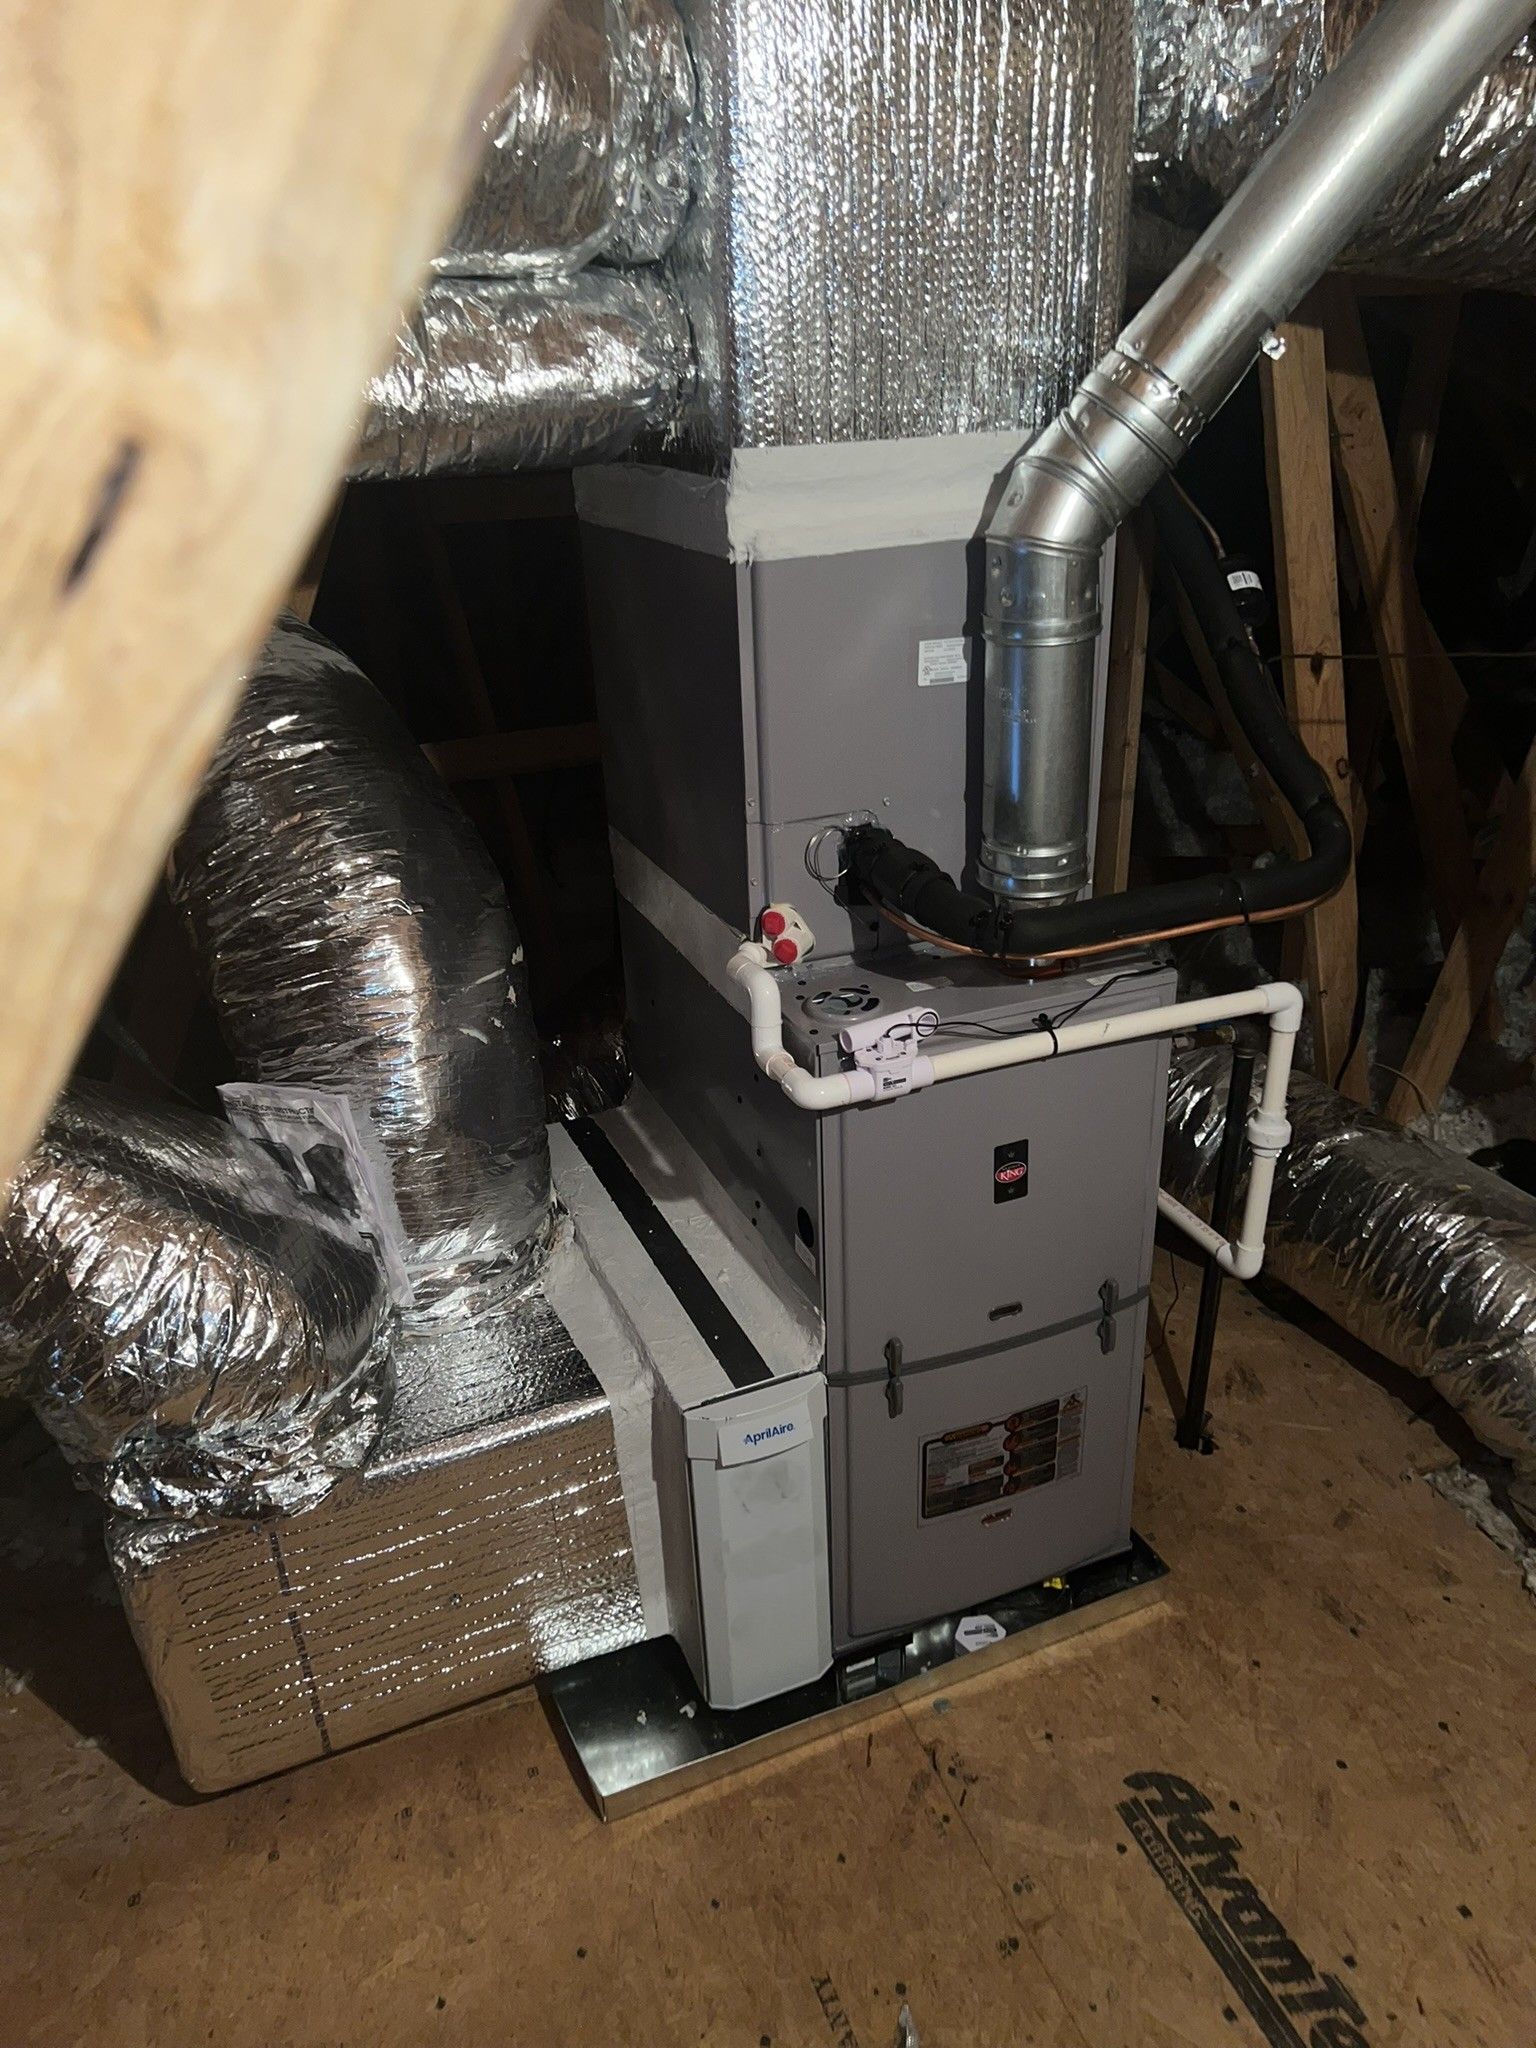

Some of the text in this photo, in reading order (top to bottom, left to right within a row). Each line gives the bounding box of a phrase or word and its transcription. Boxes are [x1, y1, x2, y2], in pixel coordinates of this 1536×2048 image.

[1000, 1167, 1025, 1180] KING
[744, 1423, 794, 1446] AprilAire
[1133, 1818, 1208, 1923] FLOORING
